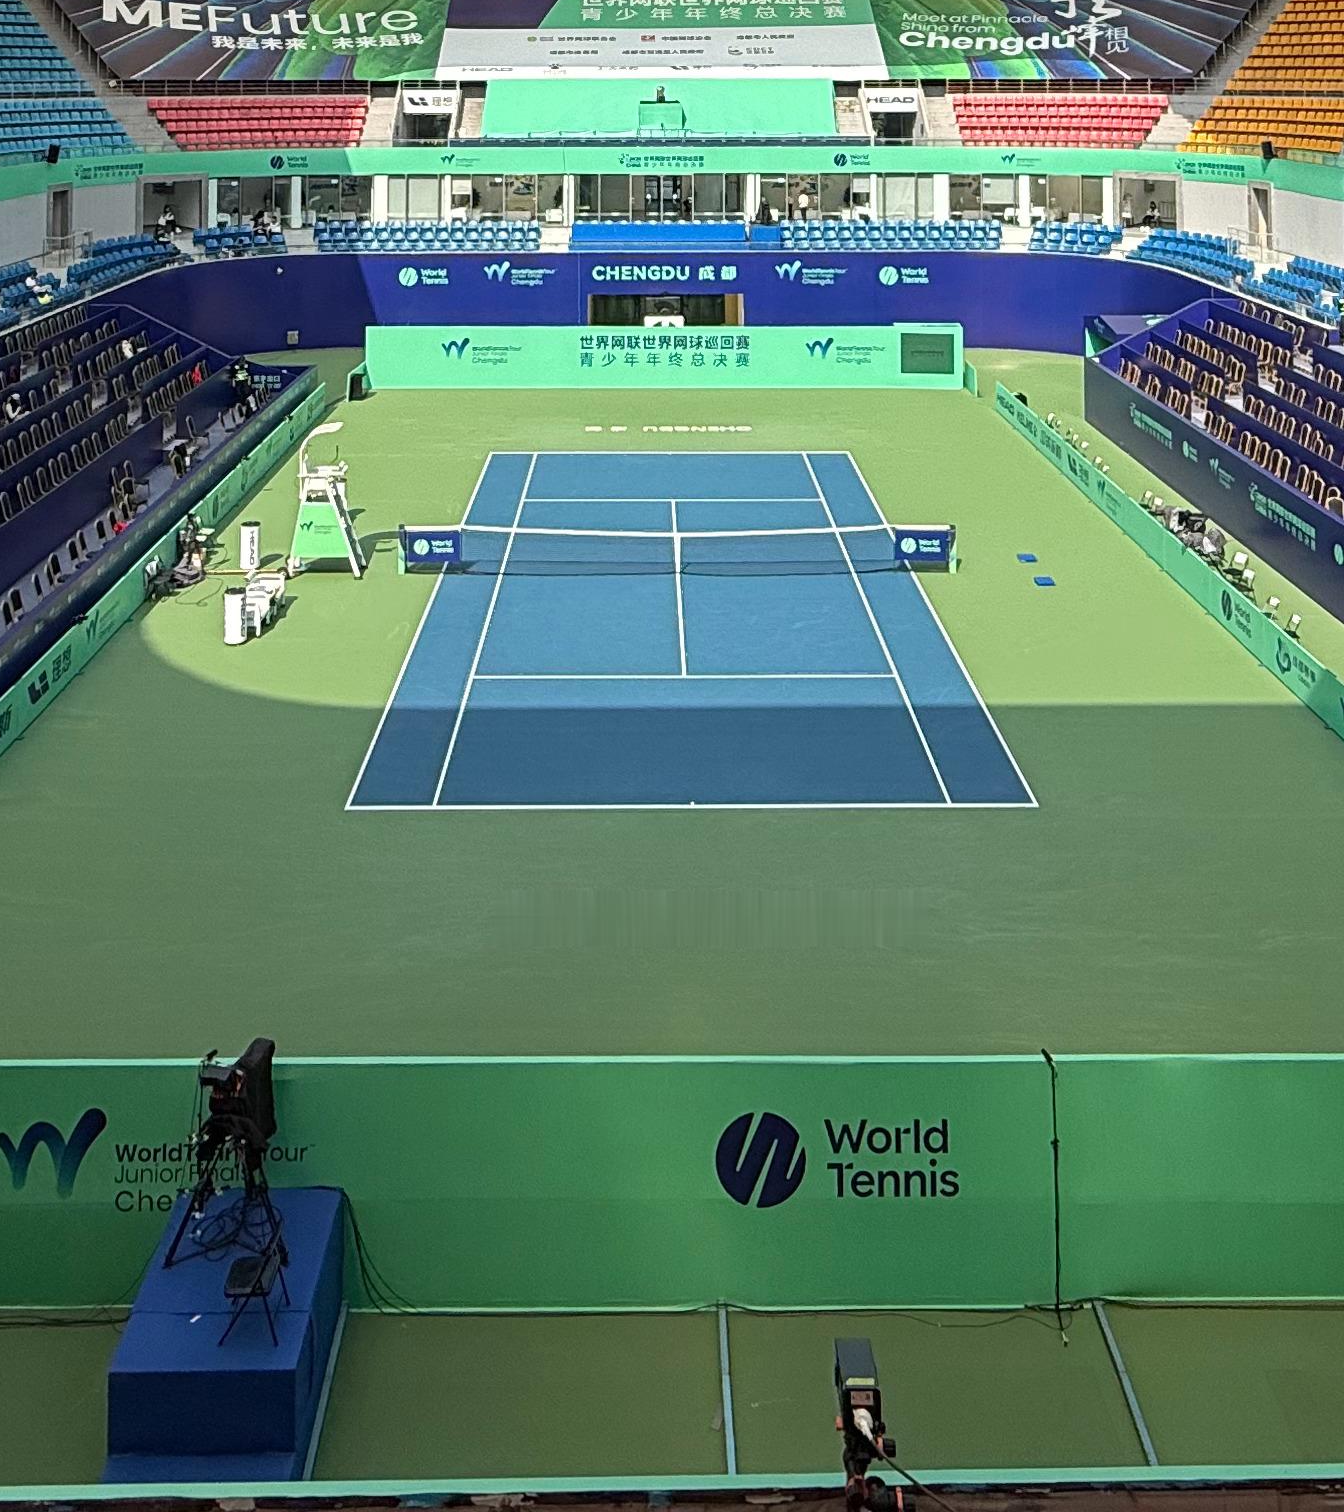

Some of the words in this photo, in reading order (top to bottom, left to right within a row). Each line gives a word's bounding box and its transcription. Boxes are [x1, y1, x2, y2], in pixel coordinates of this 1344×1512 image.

[580, 6, 846, 21] 青少年年终总决赛
[902, 13, 947, 23] Meet
[949, 14, 970, 23] at
[971, 13, 1049, 24] Pinnacle
[951, 23, 996, 33] from
[899, 32, 1075, 55] Chengdu
[867, 96, 915, 104] HEAD
[420, 268, 447, 277] World
[591, 265, 691, 281] CHENGDU
[698, 265, 738, 281] 成都
[900, 267, 928, 276] World
[421, 276, 449, 285] Tennis
[511, 278, 544, 287] Chengdu
[801, 277, 835, 286] Chengdu
[901, 275, 930, 284] Tennis
[579, 335, 750, 351] 世界网联世界网球巡回赛
[472, 355, 508, 365] Chengdu
[579, 352, 750, 368] 青少年年终总决赛
[836, 356, 871, 365] Chengdu
[432, 546, 455, 554] Tennis
[51, 644, 72, 684] 理想
[823, 1118, 949, 1155] World
[114, 1164, 183, 1184] Junior
[826, 1158, 960, 1198] Tennis
